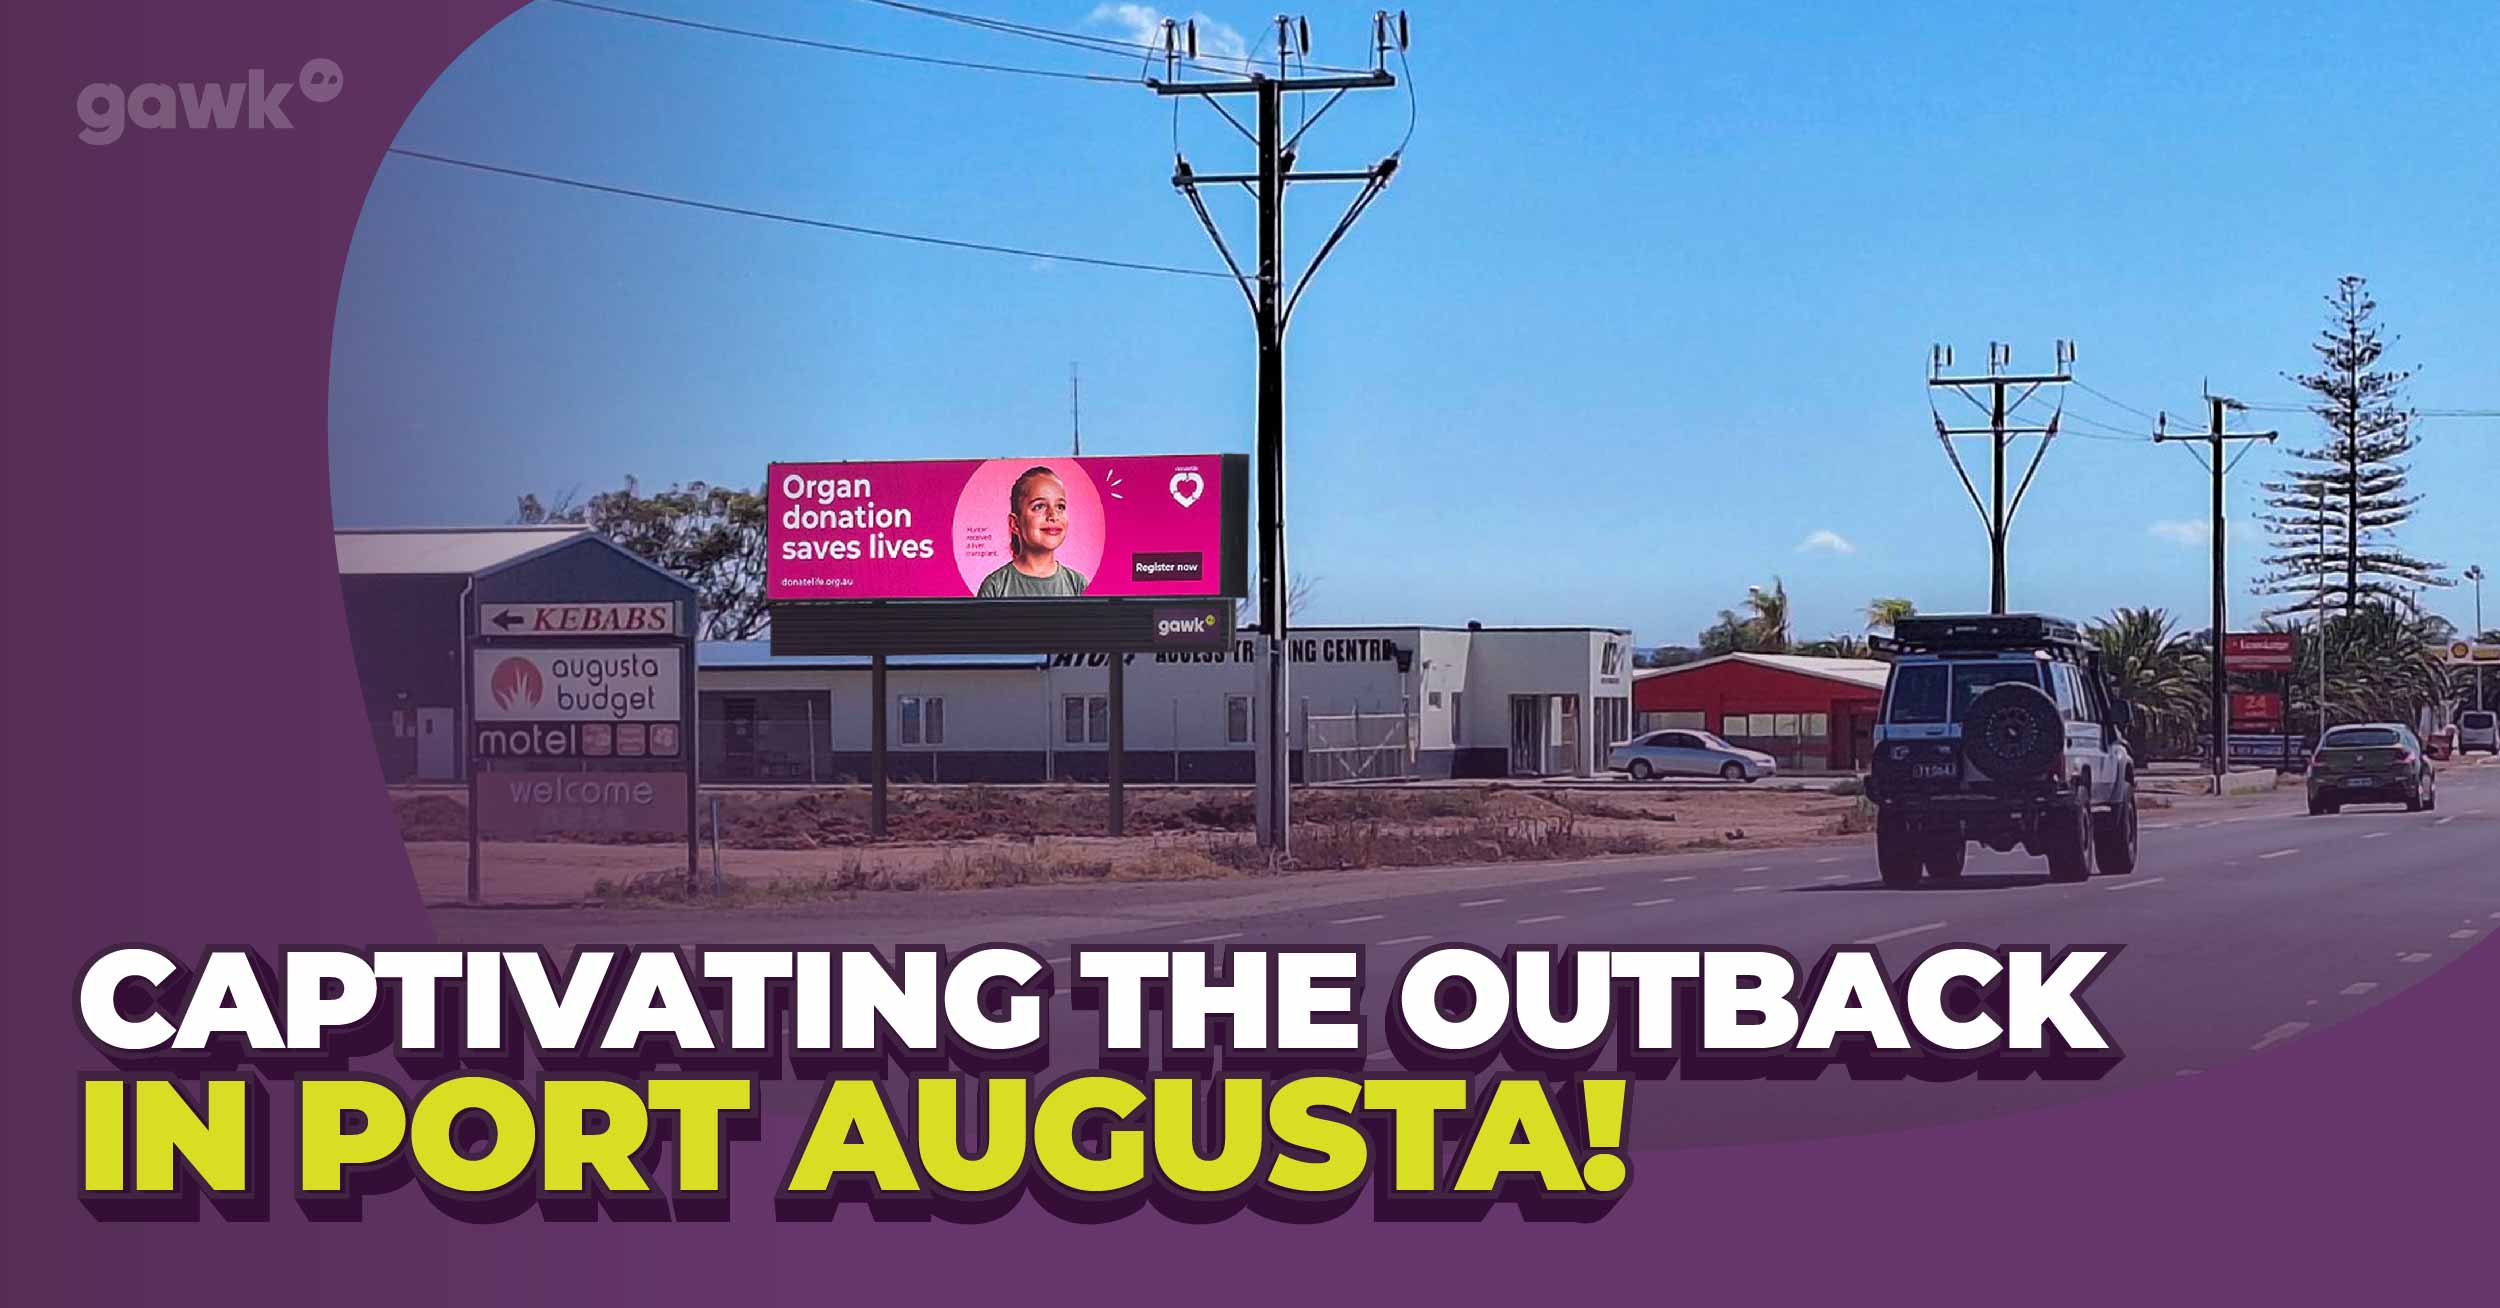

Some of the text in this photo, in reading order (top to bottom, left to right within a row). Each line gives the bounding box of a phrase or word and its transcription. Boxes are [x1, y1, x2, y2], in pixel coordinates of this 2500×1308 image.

[782, 473, 873, 503] Organ
[782, 504, 912, 530] donation
[782, 531, 934, 560] saves lives
[782, 576, 854, 588] donatelife.org.au
[1134, 561, 1198, 575] Register now
[533, 607, 667, 632] KEBABS
[1158, 617, 1205, 636] gawk
[552, 653, 659, 686] augusta
[557, 684, 655, 718] budget
[479, 723, 577, 755] motel
[510, 776, 655, 804] welcome
